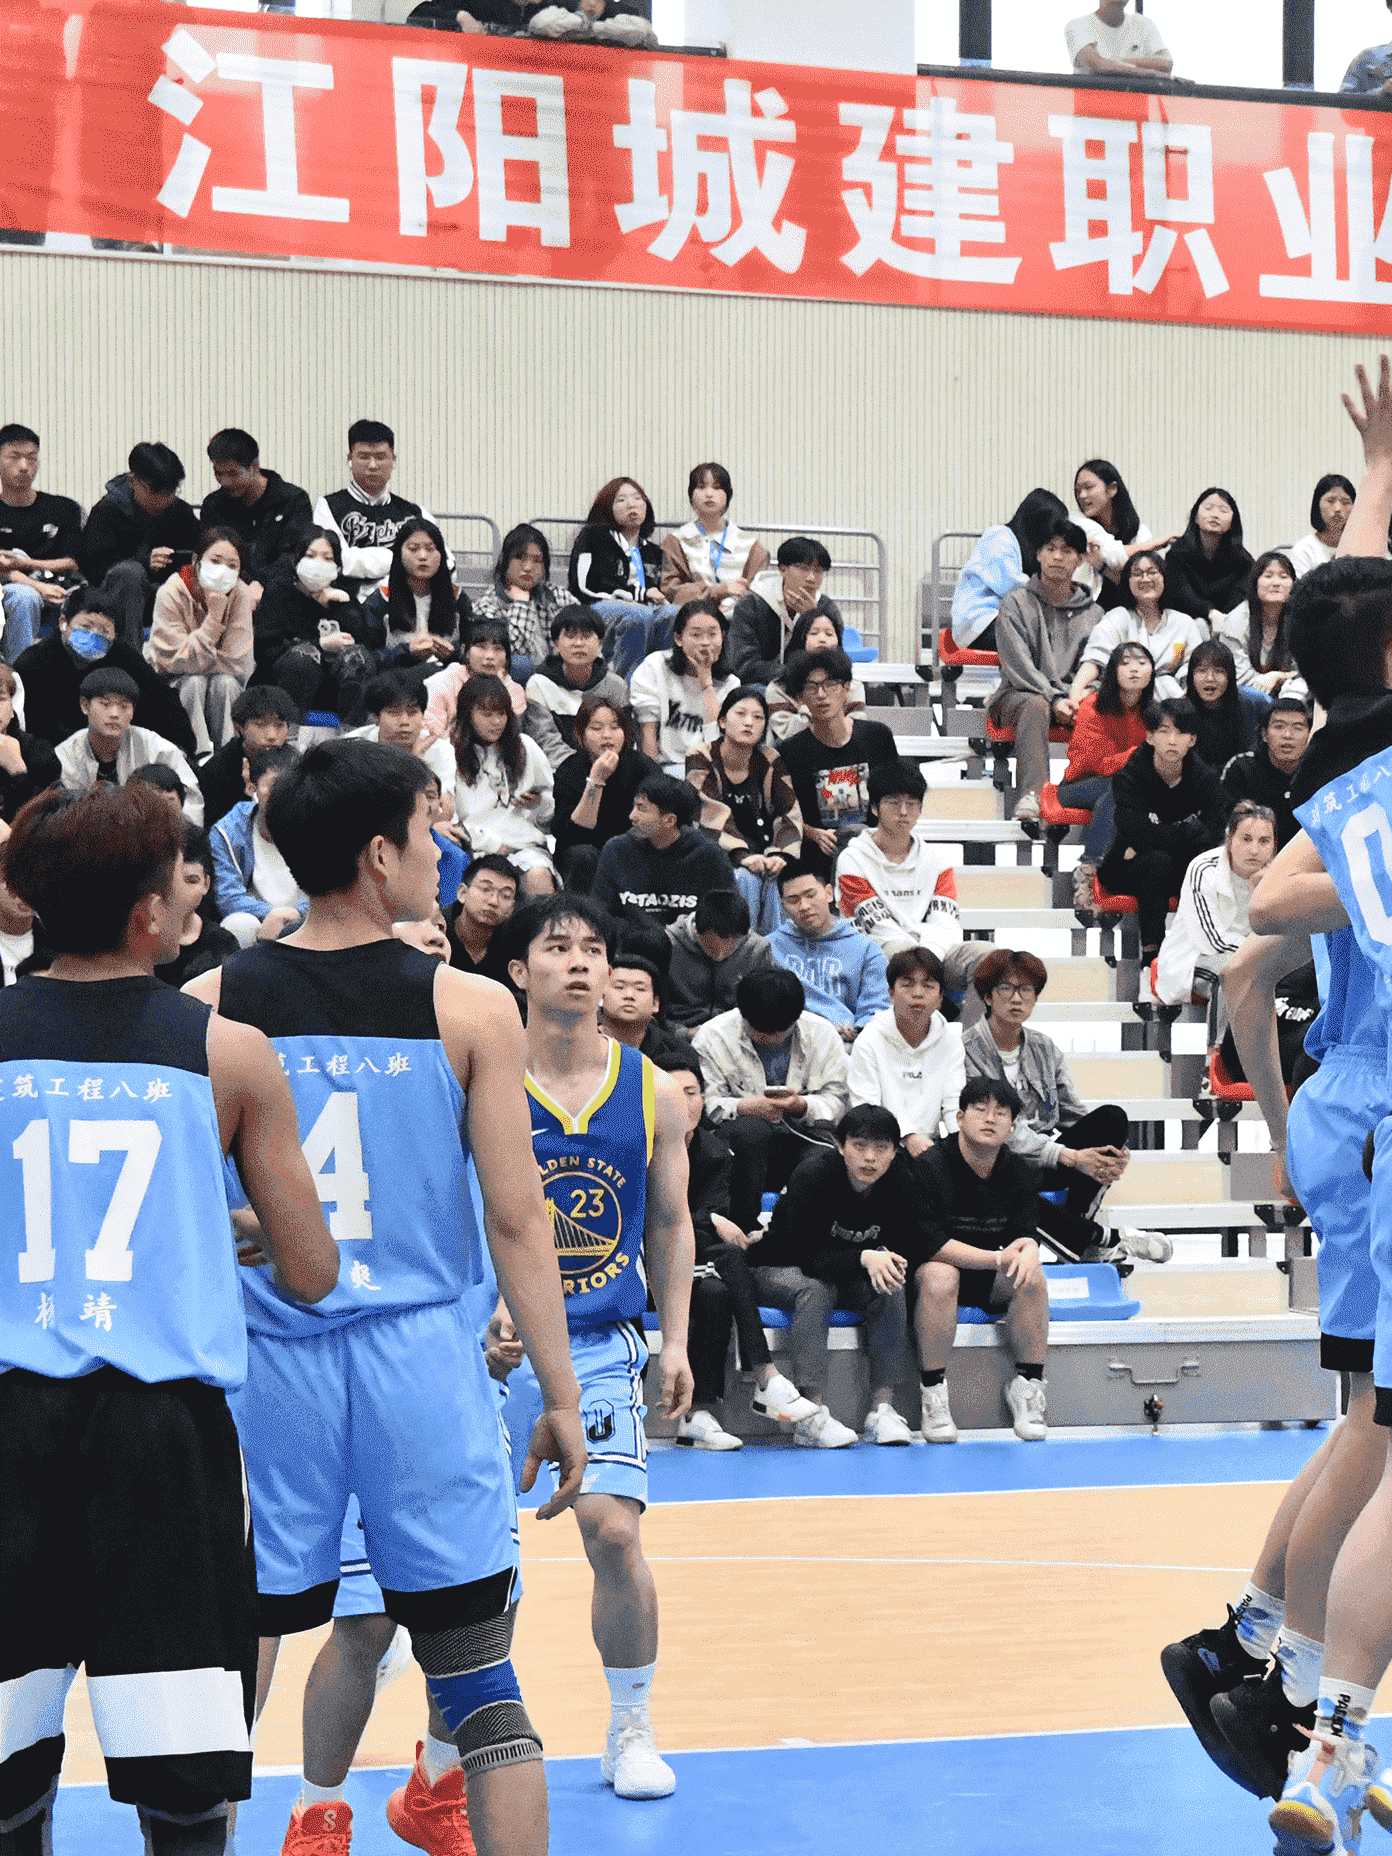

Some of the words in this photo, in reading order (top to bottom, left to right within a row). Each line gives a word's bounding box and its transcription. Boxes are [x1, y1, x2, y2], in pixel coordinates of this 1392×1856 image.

[0, 1074, 172, 1103] 筑工程八班
[301, 1092, 373, 1240] 4
[538, 1156, 580, 1176] LDEN
[587, 1157, 627, 1189] STATE
[13, 1119, 162, 1283] 17
[570, 1188, 605, 1218] 23
[563, 1252, 630, 1295] RIORS
